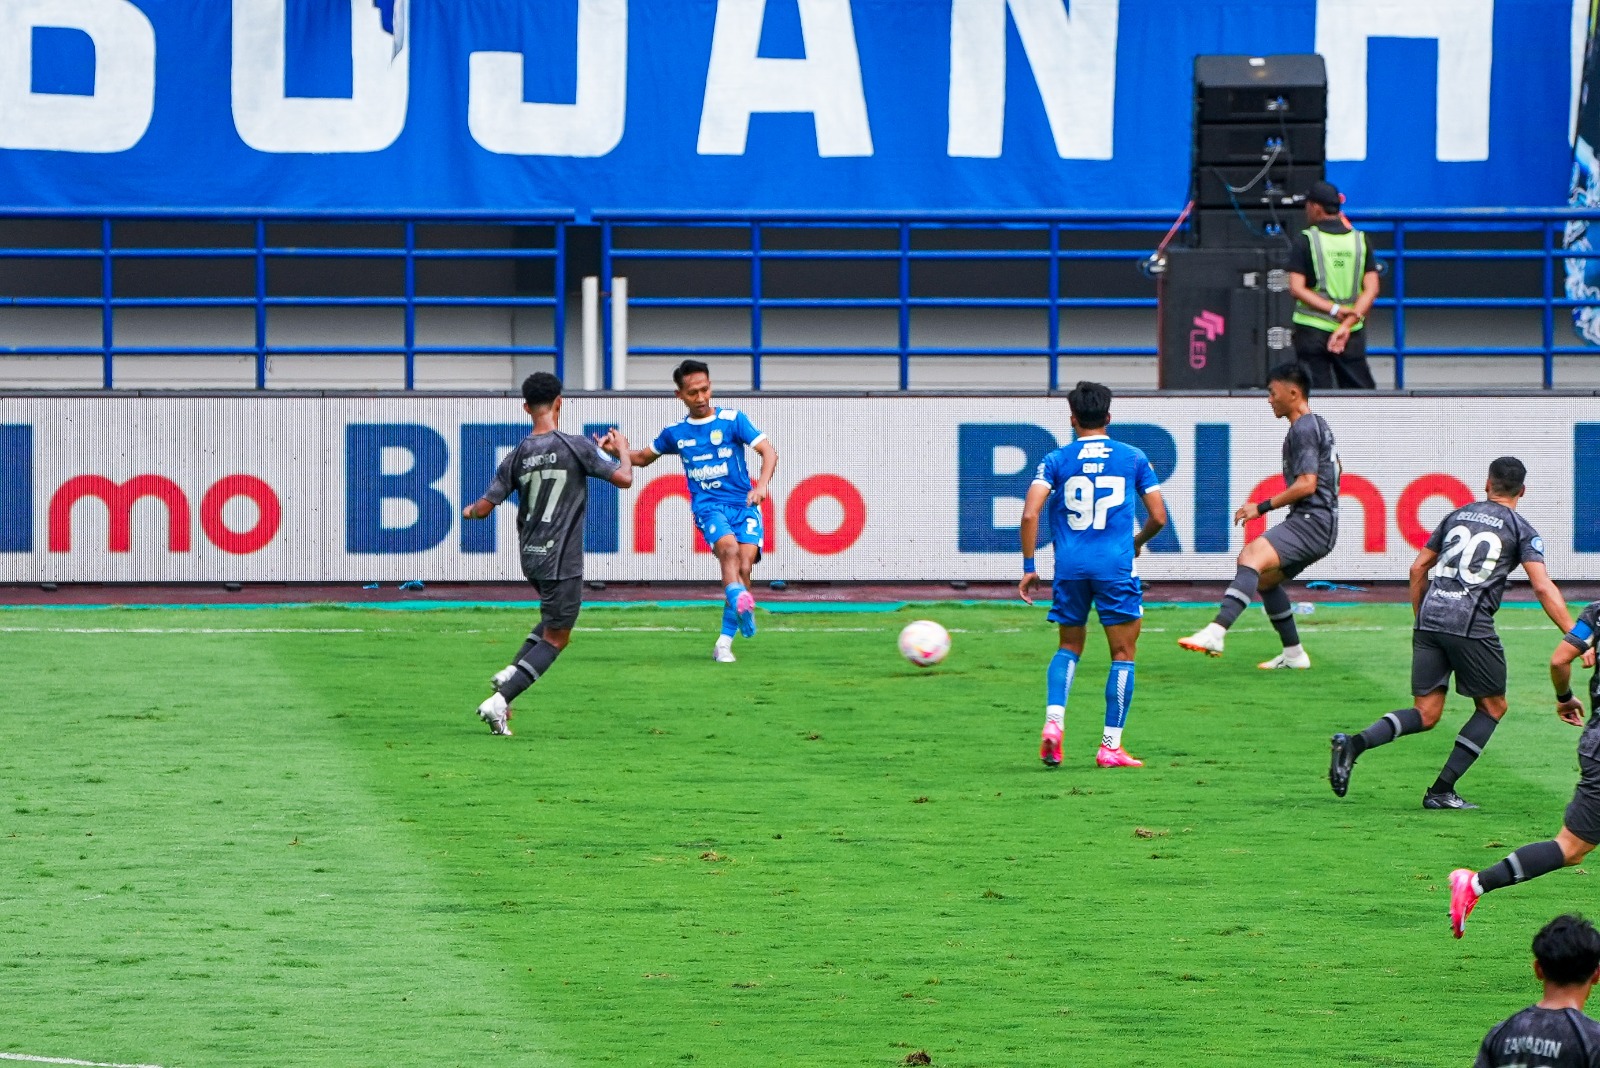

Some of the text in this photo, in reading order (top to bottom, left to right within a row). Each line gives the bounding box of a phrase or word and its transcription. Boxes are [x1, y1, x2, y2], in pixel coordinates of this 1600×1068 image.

[1311, 0, 1587, 162] H
[519, 469, 567, 522] 77
[1064, 475, 1125, 531] 97
[1456, 511, 1504, 530] BELLEGGIA
[1435, 524, 1503, 584] 20
